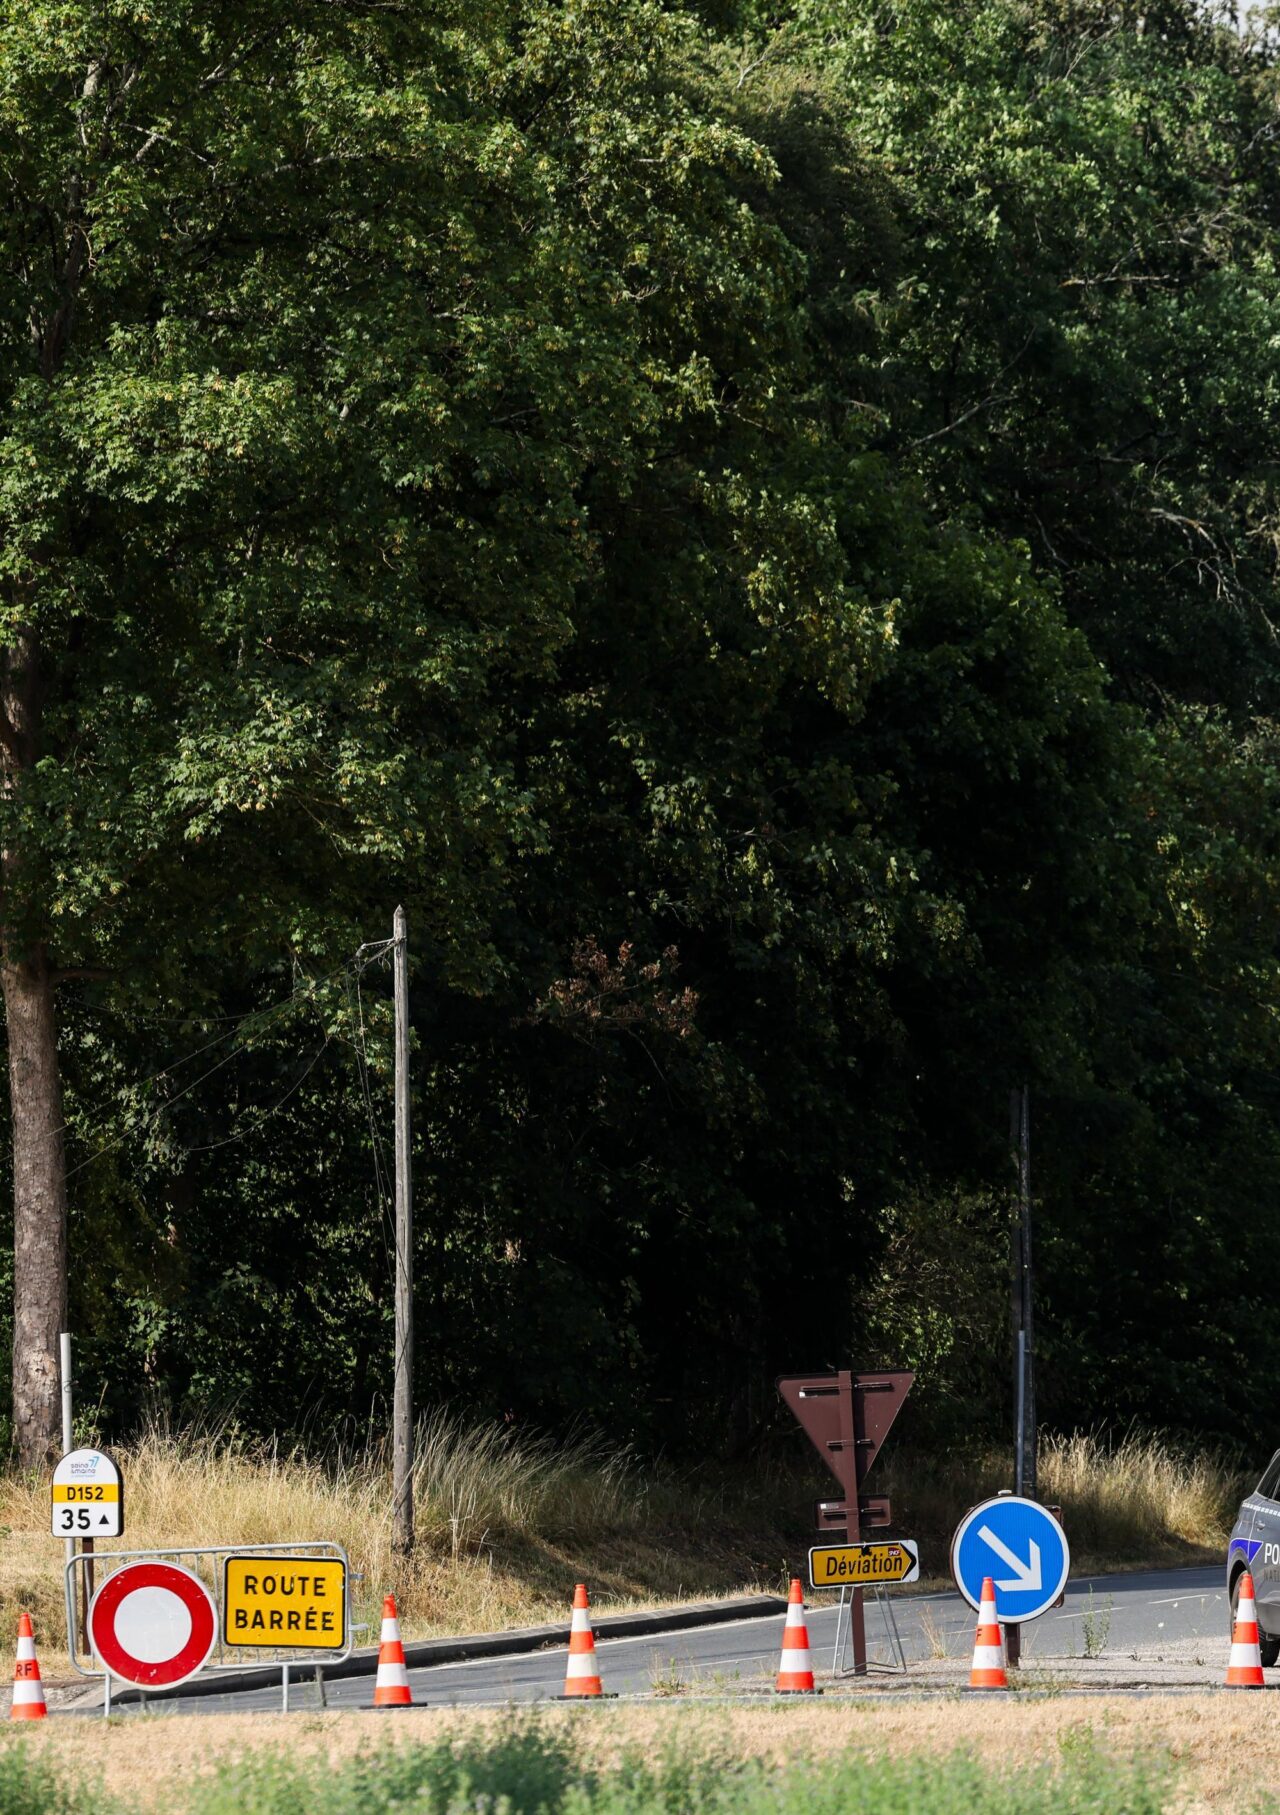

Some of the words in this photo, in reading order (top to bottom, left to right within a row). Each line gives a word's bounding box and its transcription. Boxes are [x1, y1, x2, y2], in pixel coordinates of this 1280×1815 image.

[67, 1487, 104, 1500] D152
[61, 1508, 91, 1530] 35
[826, 1553, 902, 1576] Déviation
[244, 1575, 326, 1596] ROUTE
[235, 1606, 334, 1631] BARRÉE
[15, 1663, 32, 1677] RF
